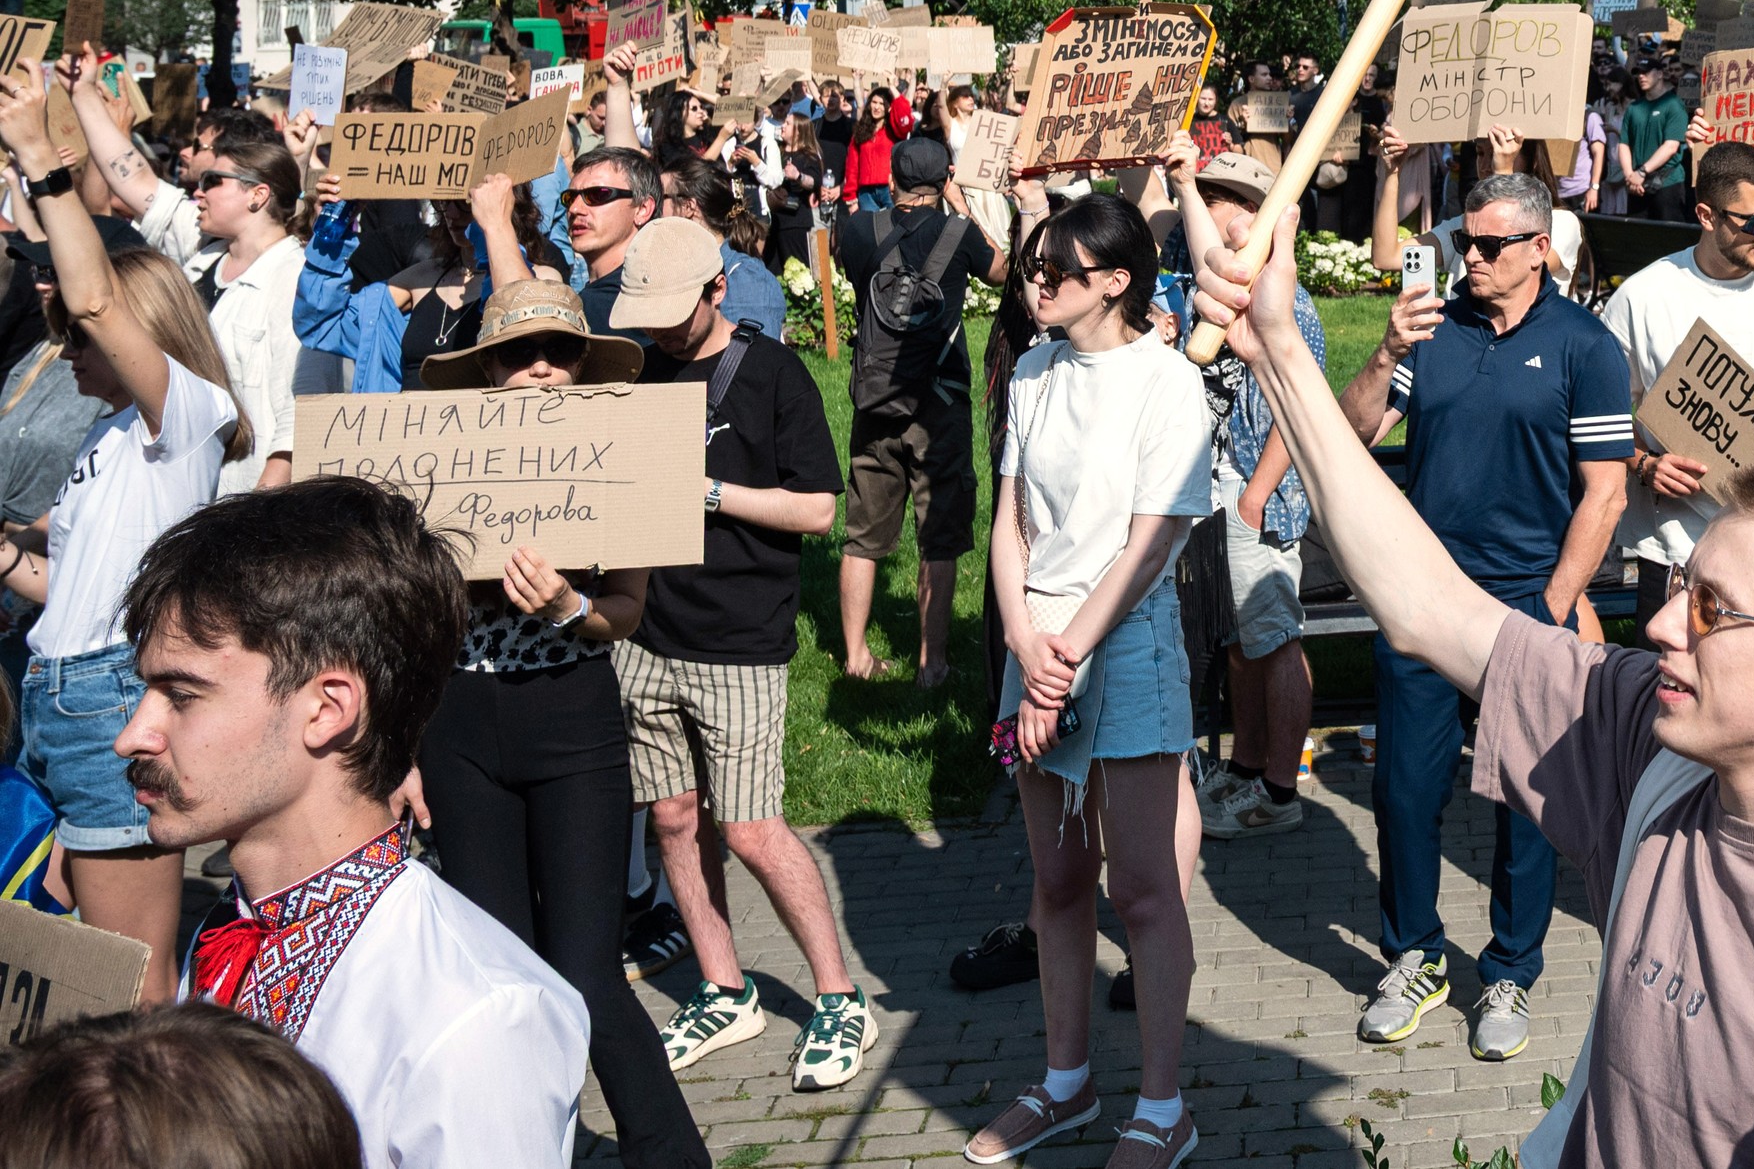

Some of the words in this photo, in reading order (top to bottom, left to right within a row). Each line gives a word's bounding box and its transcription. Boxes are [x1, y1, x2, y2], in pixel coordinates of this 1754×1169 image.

[1053, 43, 1092, 62] АБО
[637, 54, 683, 82] ПРОТИ
[301, 92, 335, 107] РІШЕНЬ
[1410, 88, 1552, 122] ОБОРОНИ
[343, 123, 477, 156] ФЕДОРОВ
[975, 115, 1008, 138] НЕ
[483, 116, 557, 171] ФЕДОРОВ
[376, 163, 427, 187] НАШ
[458, 484, 598, 544] Федорова
